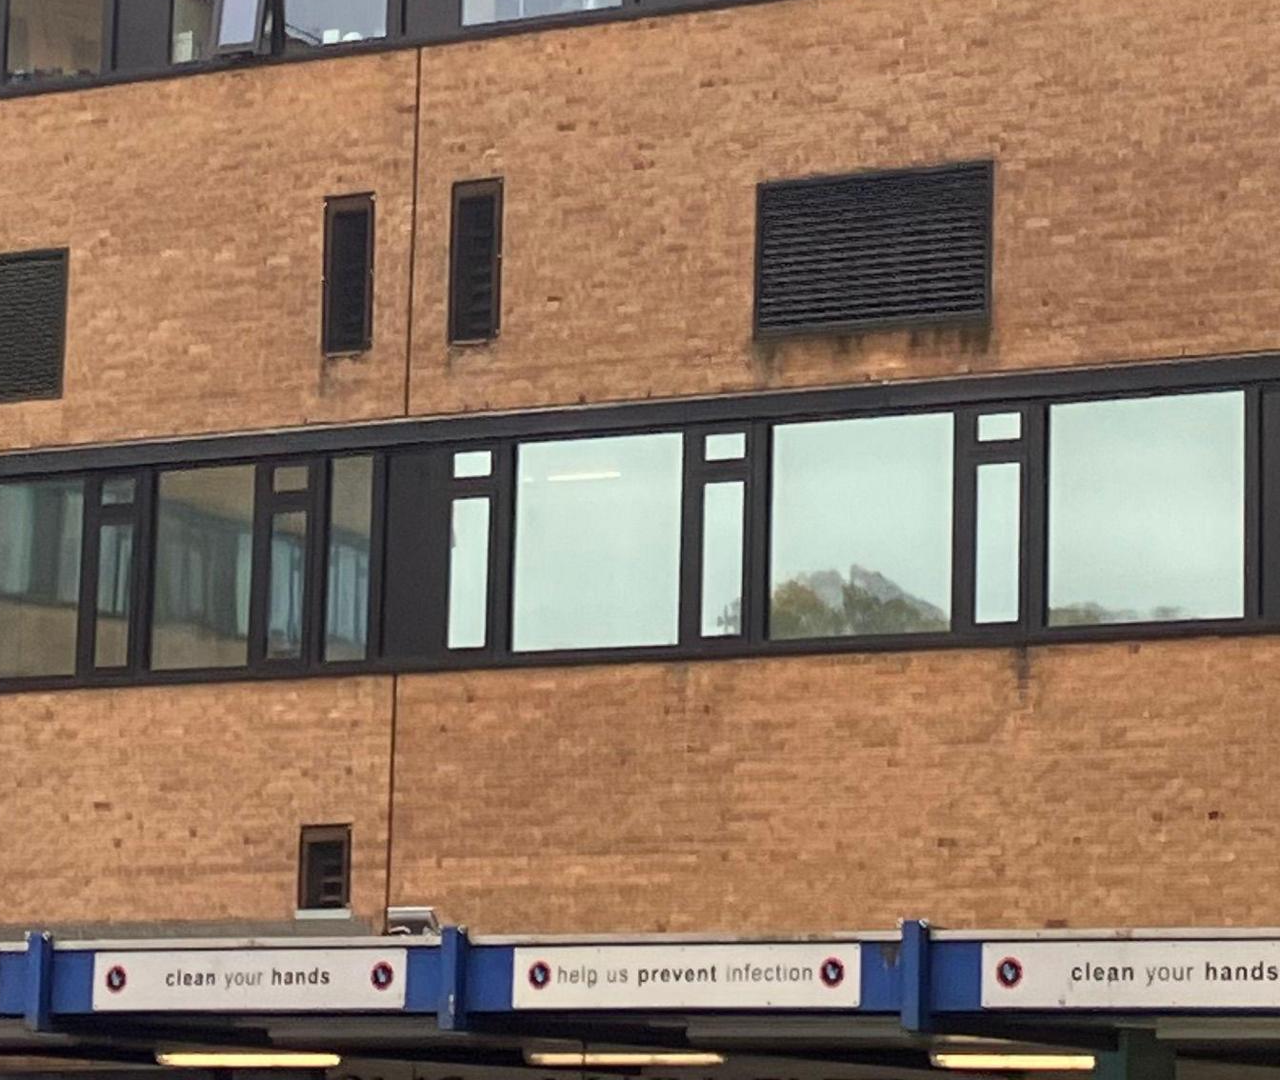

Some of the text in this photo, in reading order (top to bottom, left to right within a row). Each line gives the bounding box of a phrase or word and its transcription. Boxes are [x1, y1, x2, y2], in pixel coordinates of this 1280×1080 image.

[165, 967, 331, 990] clean your hands
[557, 963, 814, 988] help us prevent infection
[1070, 961, 1279, 987] clean your hands
